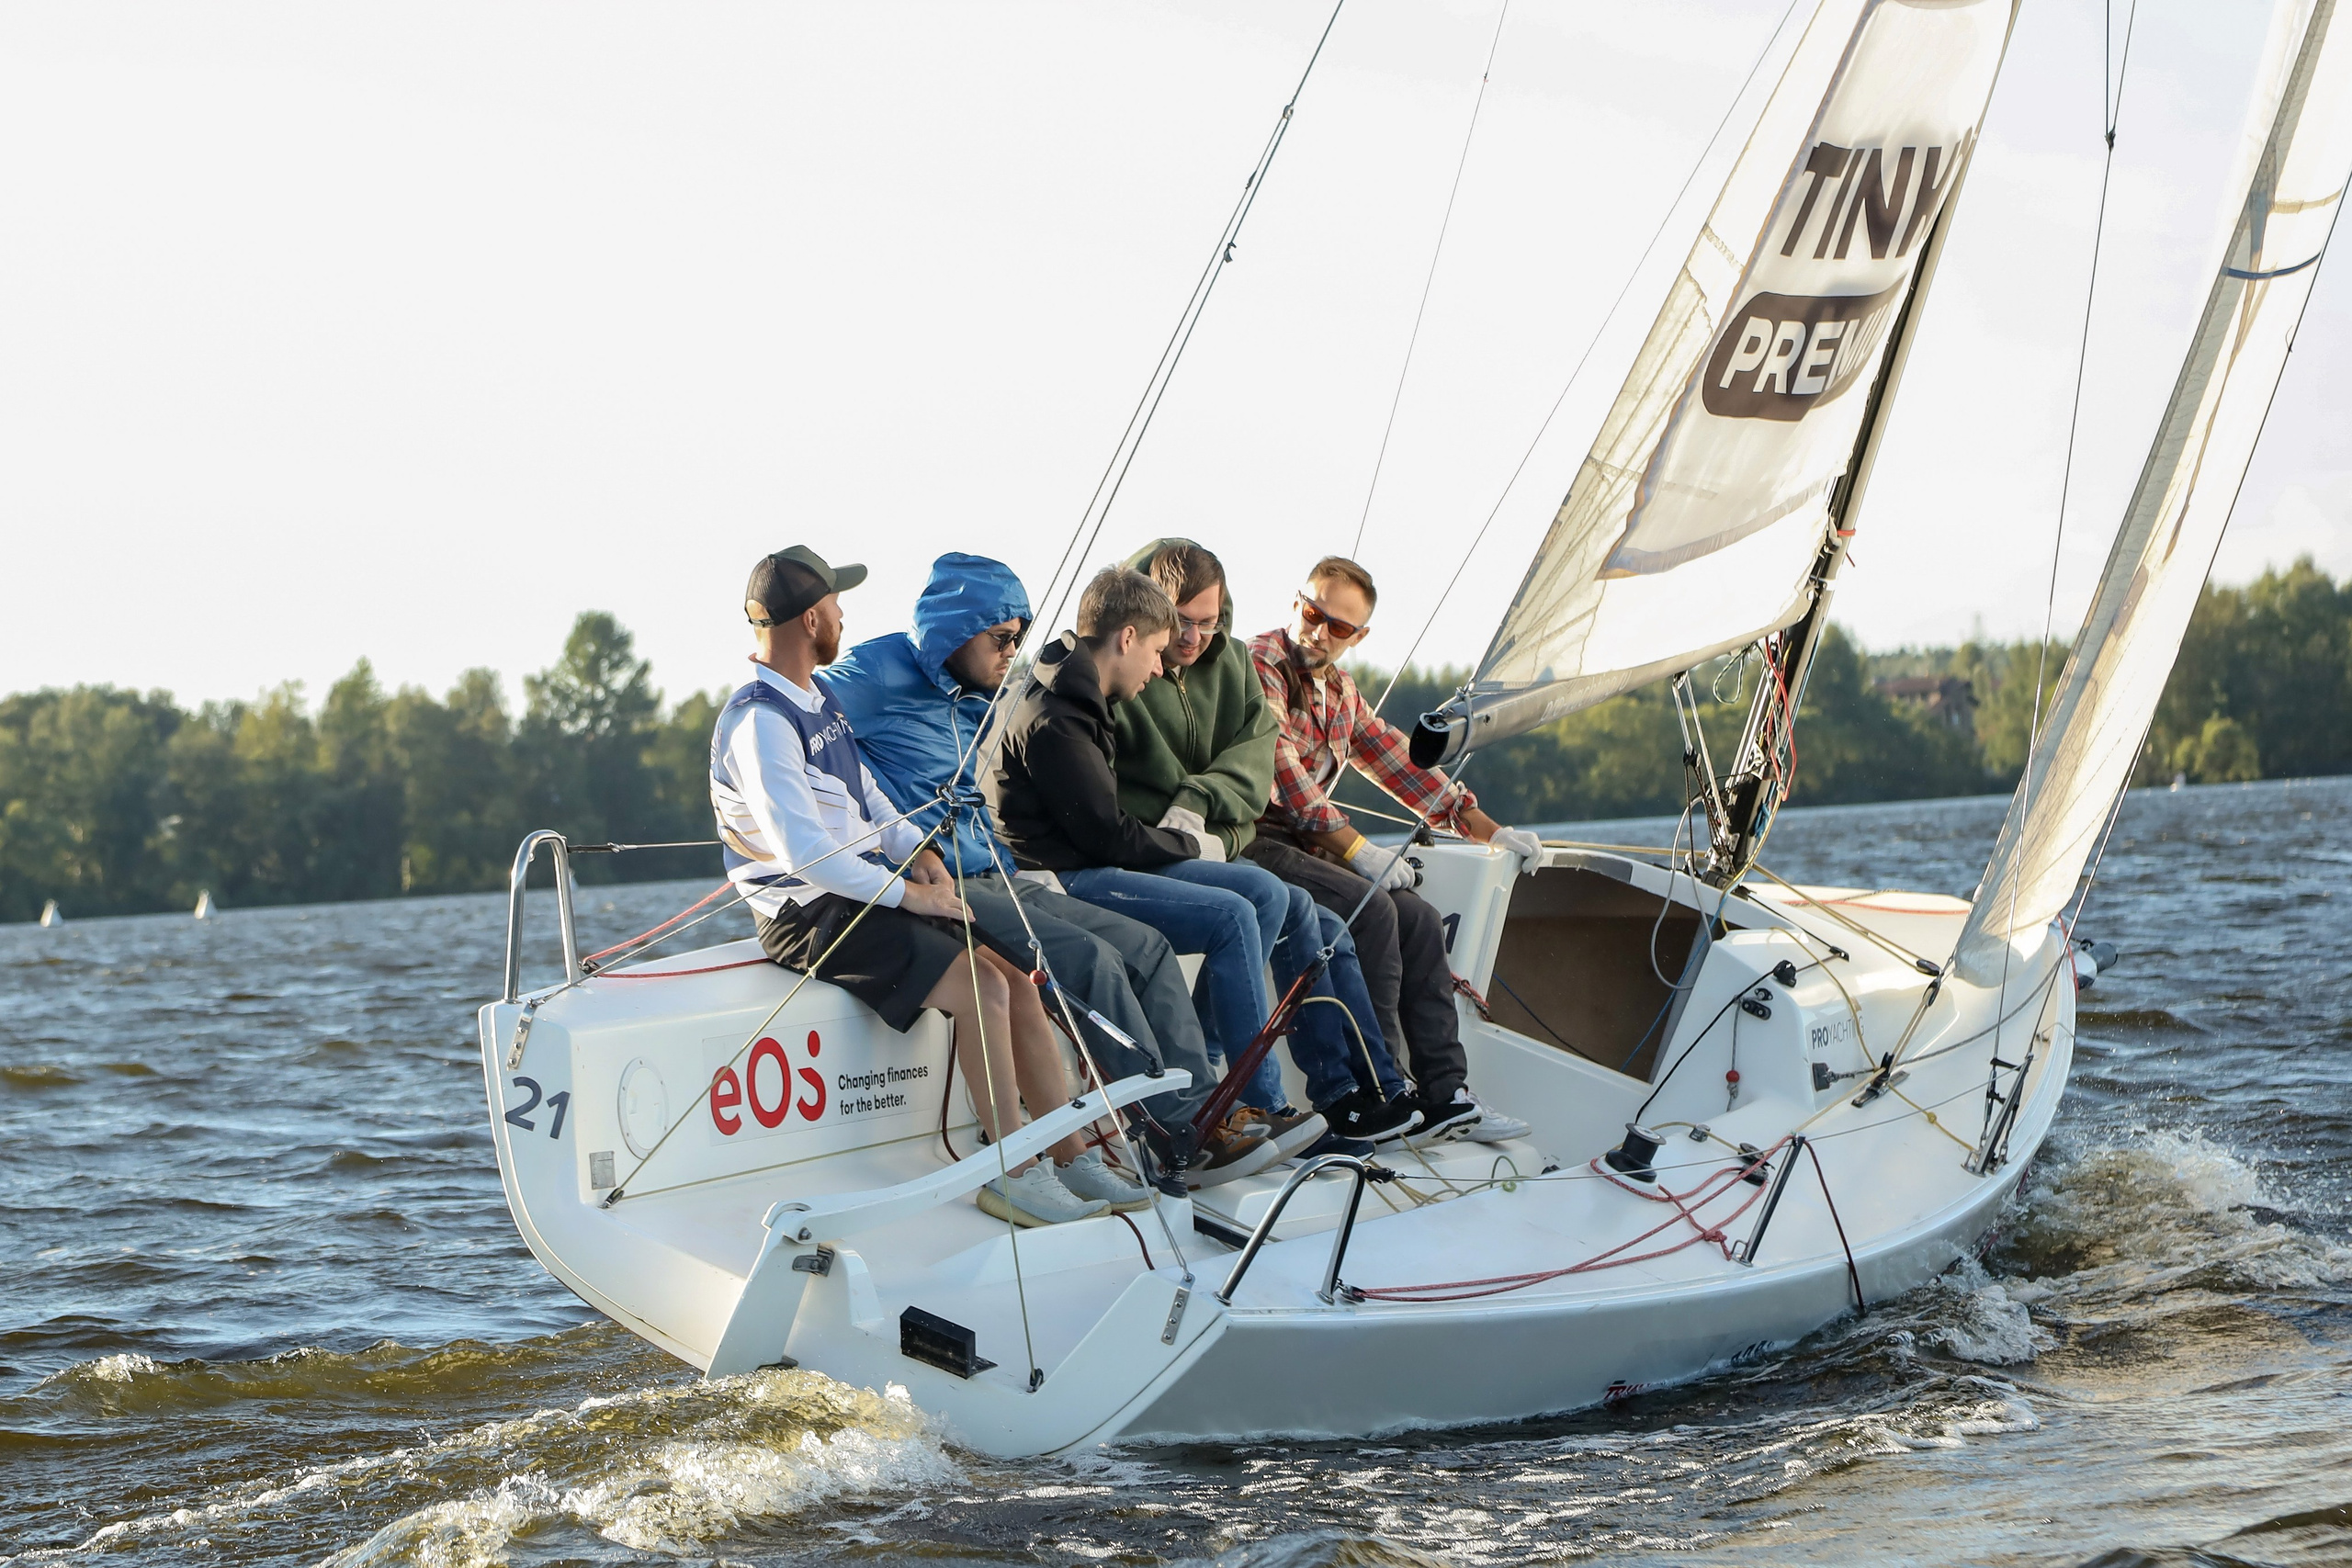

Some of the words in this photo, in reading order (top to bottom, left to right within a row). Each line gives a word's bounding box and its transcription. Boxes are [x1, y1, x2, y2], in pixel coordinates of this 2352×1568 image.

[838, 1070, 886, 1090] Changing
[888, 1066, 929, 1083] finances
[504, 1077, 571, 1140] 21
[840, 1100, 854, 1115] for
[856, 1097, 873, 1112] the
[874, 1093, 907, 1110] better.
